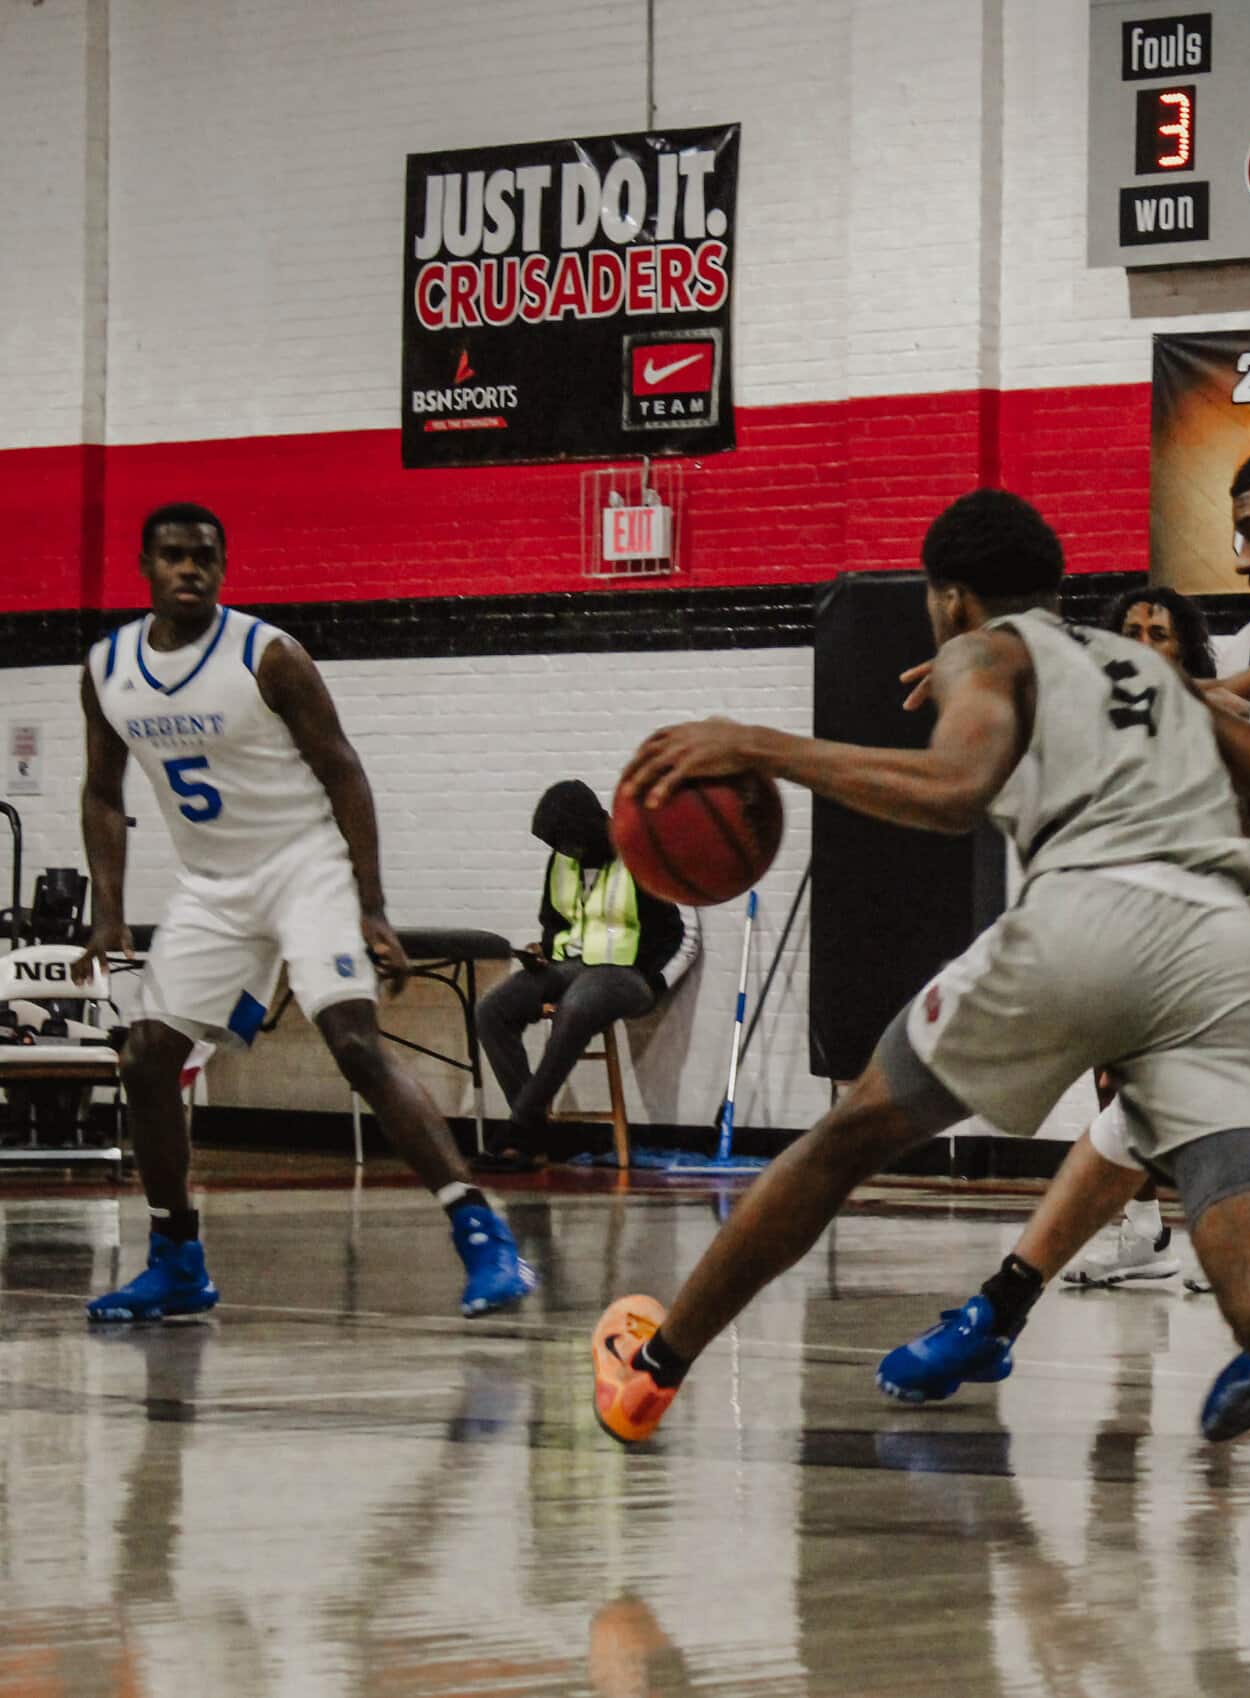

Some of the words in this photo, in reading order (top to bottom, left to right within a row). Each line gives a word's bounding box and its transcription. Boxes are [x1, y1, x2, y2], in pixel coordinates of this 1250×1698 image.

[1131, 24, 1202, 71] fouls
[1158, 92, 1190, 167] 3
[414, 165, 552, 260] JUST
[561, 156, 648, 249] DO
[655, 150, 727, 240] IT.
[1135, 196, 1194, 233] won
[414, 240, 728, 331] CRUSADERS
[639, 398, 704, 416] TEAM
[613, 508, 656, 554] EXIT
[163, 755, 222, 822] 5
[14, 961, 67, 981] NG
